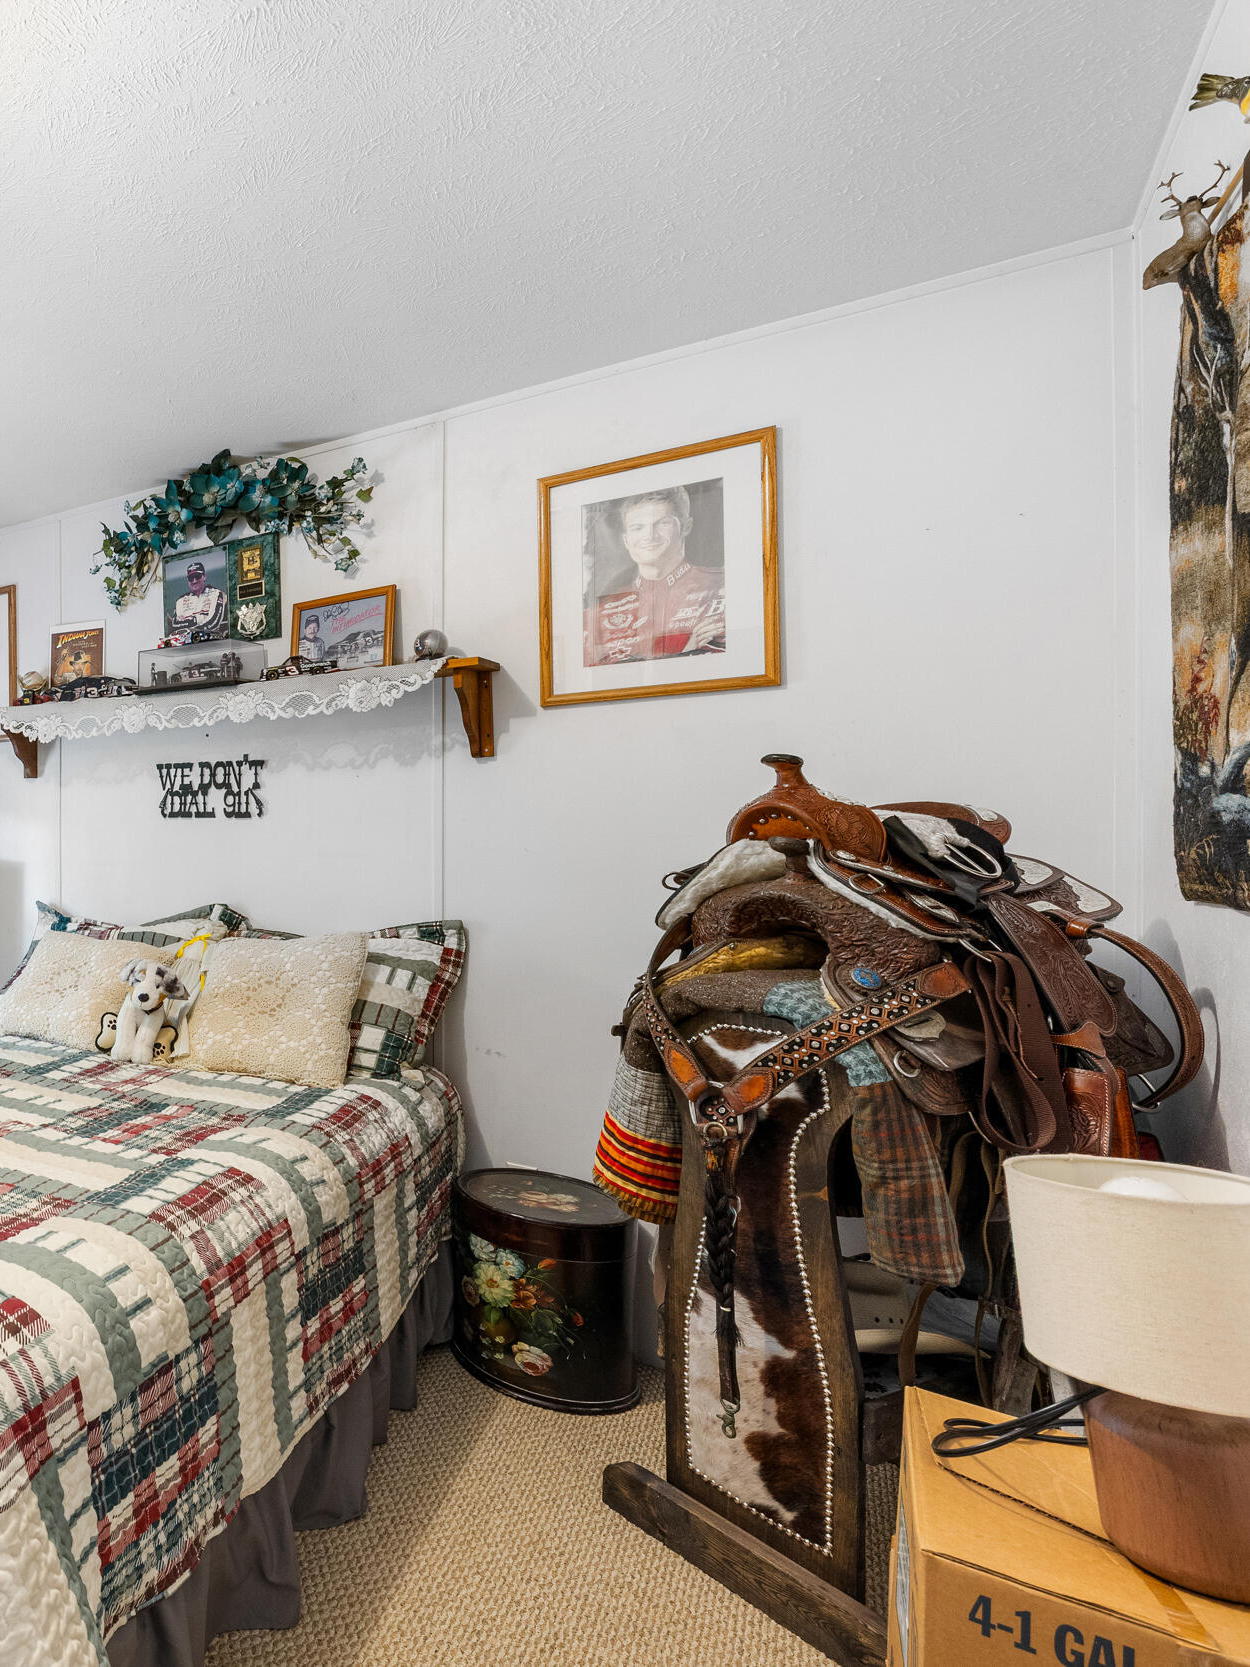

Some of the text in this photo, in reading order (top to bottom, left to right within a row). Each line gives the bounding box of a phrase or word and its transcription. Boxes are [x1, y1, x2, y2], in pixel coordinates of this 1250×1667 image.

[285, 665, 299, 675] 3
[86, 687, 100, 698] 3
[156, 754, 265, 791] WE DON'T
[168, 789, 251, 818] DIAL 911
[968, 1594, 1037, 1655] 4-1
